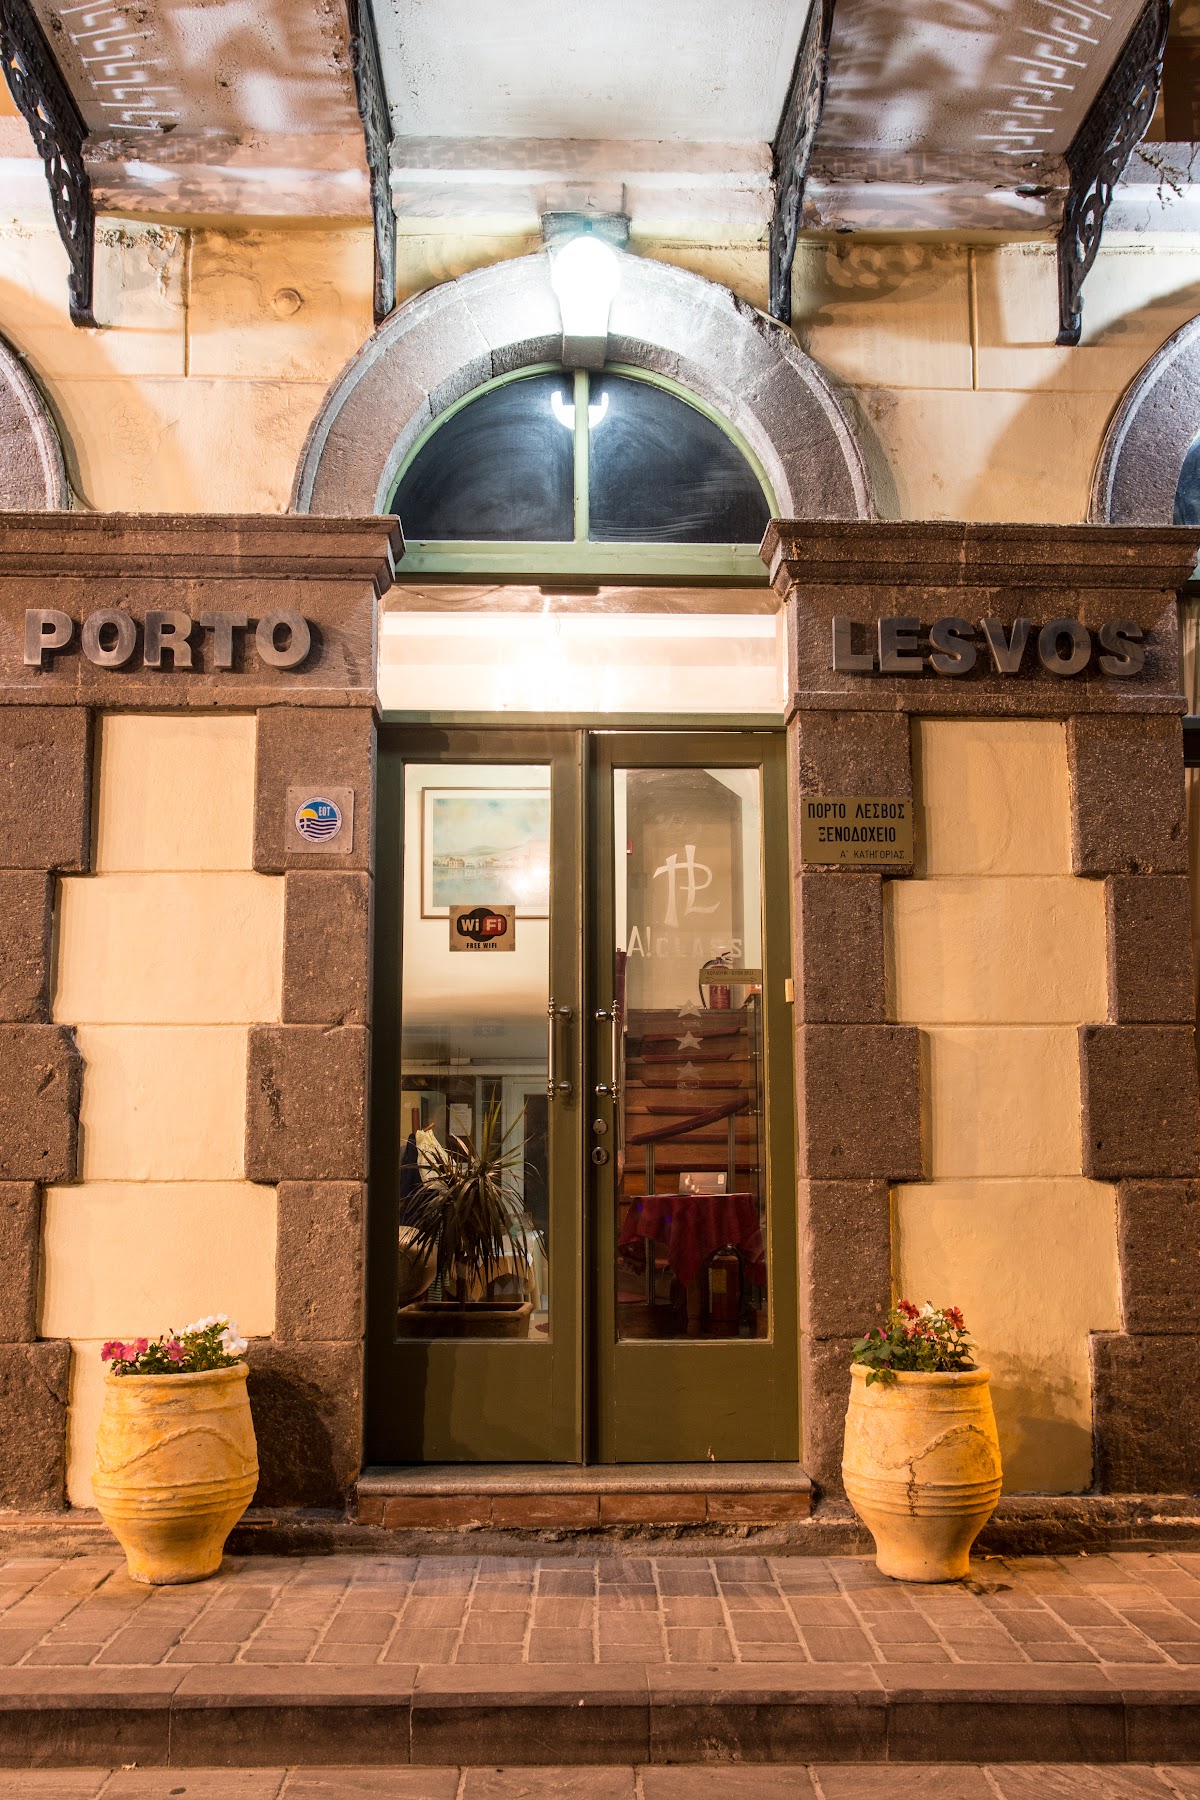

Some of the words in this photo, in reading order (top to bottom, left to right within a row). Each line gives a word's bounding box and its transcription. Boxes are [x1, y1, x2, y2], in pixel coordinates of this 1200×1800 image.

[24, 608, 312, 669] PORTO
[832, 616, 1146, 676] LESVOS
[807, 803, 846, 819] ΠΟΡΤΟ
[855, 803, 905, 819] ΛΕΣΒΟΣ
[818, 826, 896, 842] ΞΕΝΟΔΟΧΕΙΟ
[853, 850, 905, 859] ΚΑΤΗΓΟΡΙΑΣ
